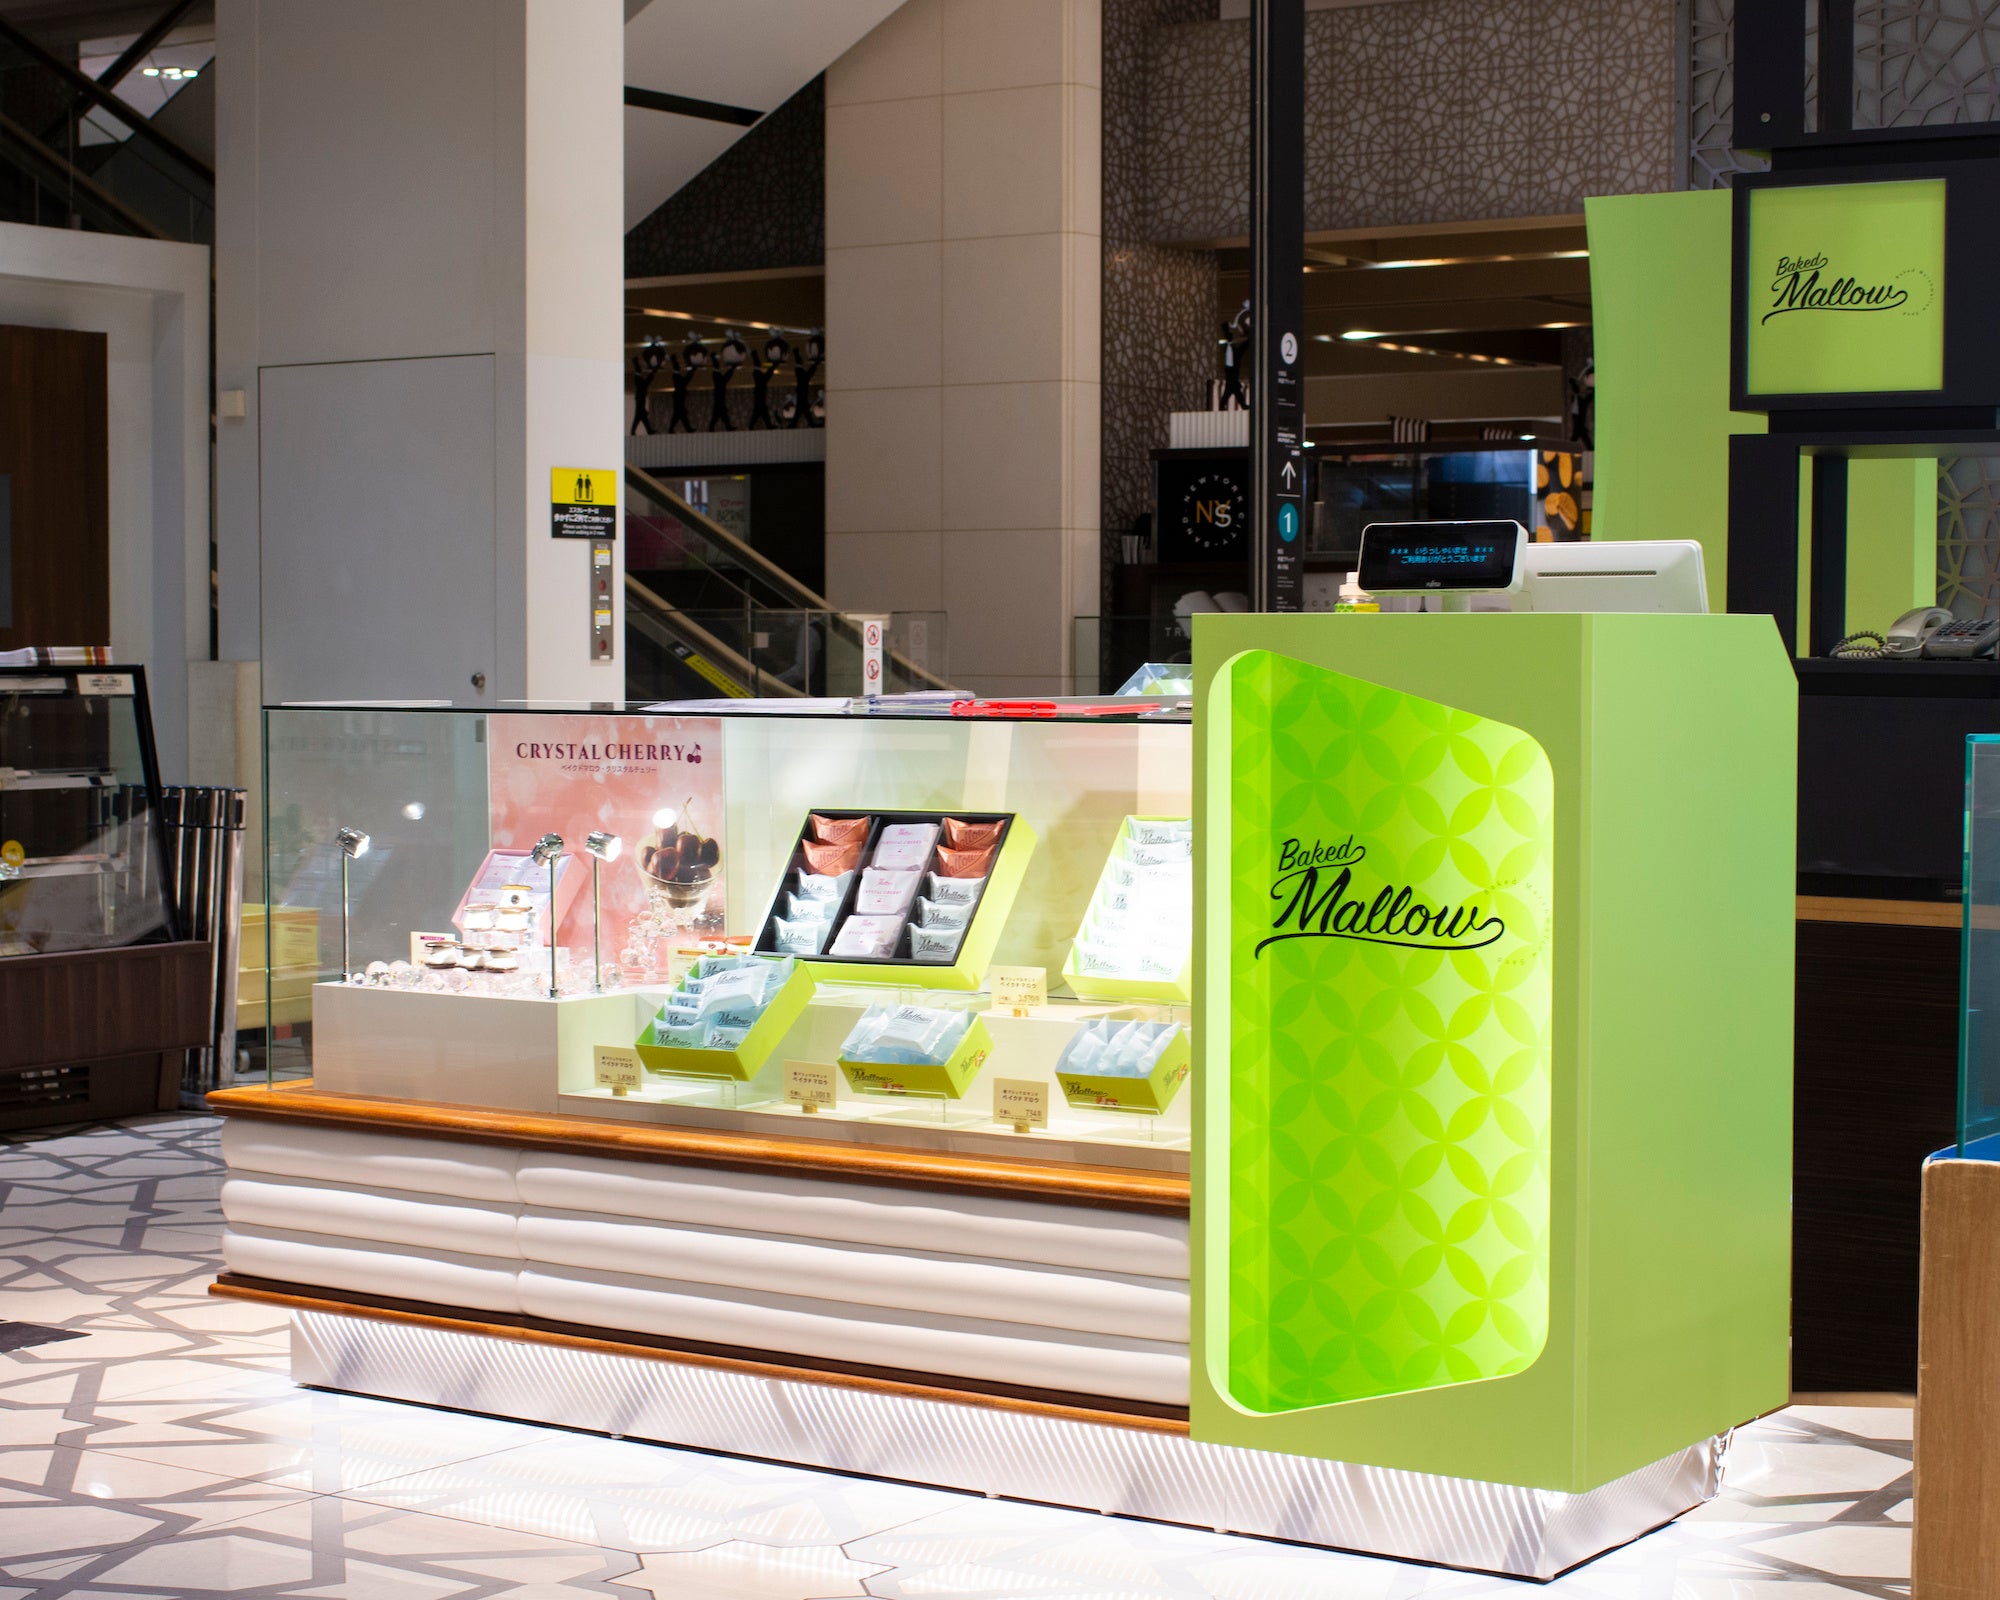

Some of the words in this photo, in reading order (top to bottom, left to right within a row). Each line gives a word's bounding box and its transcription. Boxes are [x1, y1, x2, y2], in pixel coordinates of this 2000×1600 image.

[1773, 251, 1829, 281] Baked
[1763, 270, 1909, 323] Mallow
[1415, 546, 1468, 555] いらっしゃいませ
[516, 742, 601, 760] CRYSTAL
[604, 743, 686, 761] CHERRY
[1273, 833, 1367, 879] Baked
[1256, 867, 1505, 956] Mallow
[917, 939, 953, 954] Mallow
[718, 1011, 752, 1026] Mallow
[852, 1070, 894, 1083] Mallow
[1067, 1084, 1109, 1097] Mallow
